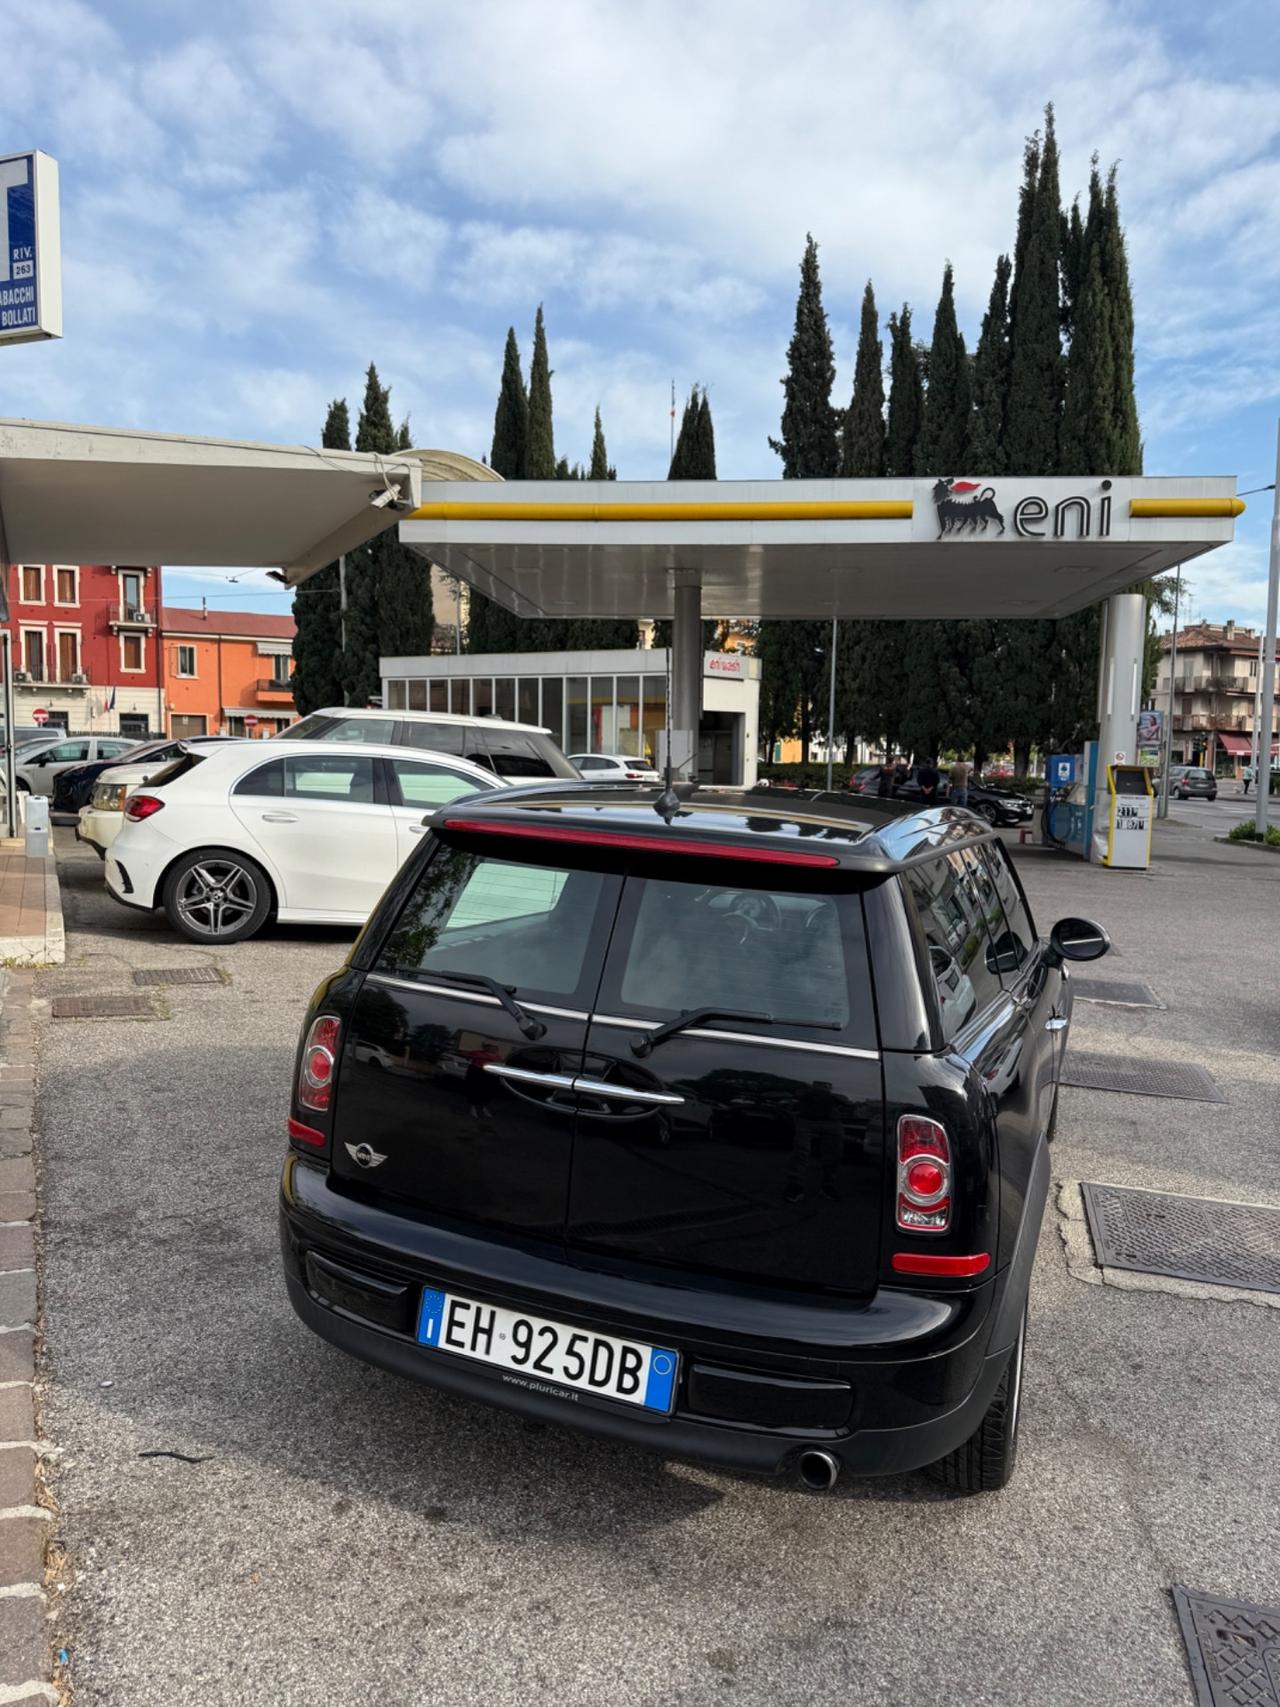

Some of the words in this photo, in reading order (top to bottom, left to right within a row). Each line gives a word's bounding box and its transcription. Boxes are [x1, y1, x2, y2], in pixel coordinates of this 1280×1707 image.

[13, 246, 32, 260] RIV.
[16, 264, 31, 275] 263
[1, 306, 36, 327] BOLLATI
[1014, 480, 1112, 537] eni
[445, 1299, 496, 1356] EH
[510, 1318, 643, 1396] 925DB
[502, 1374, 579, 1401] www.pluricar.it
